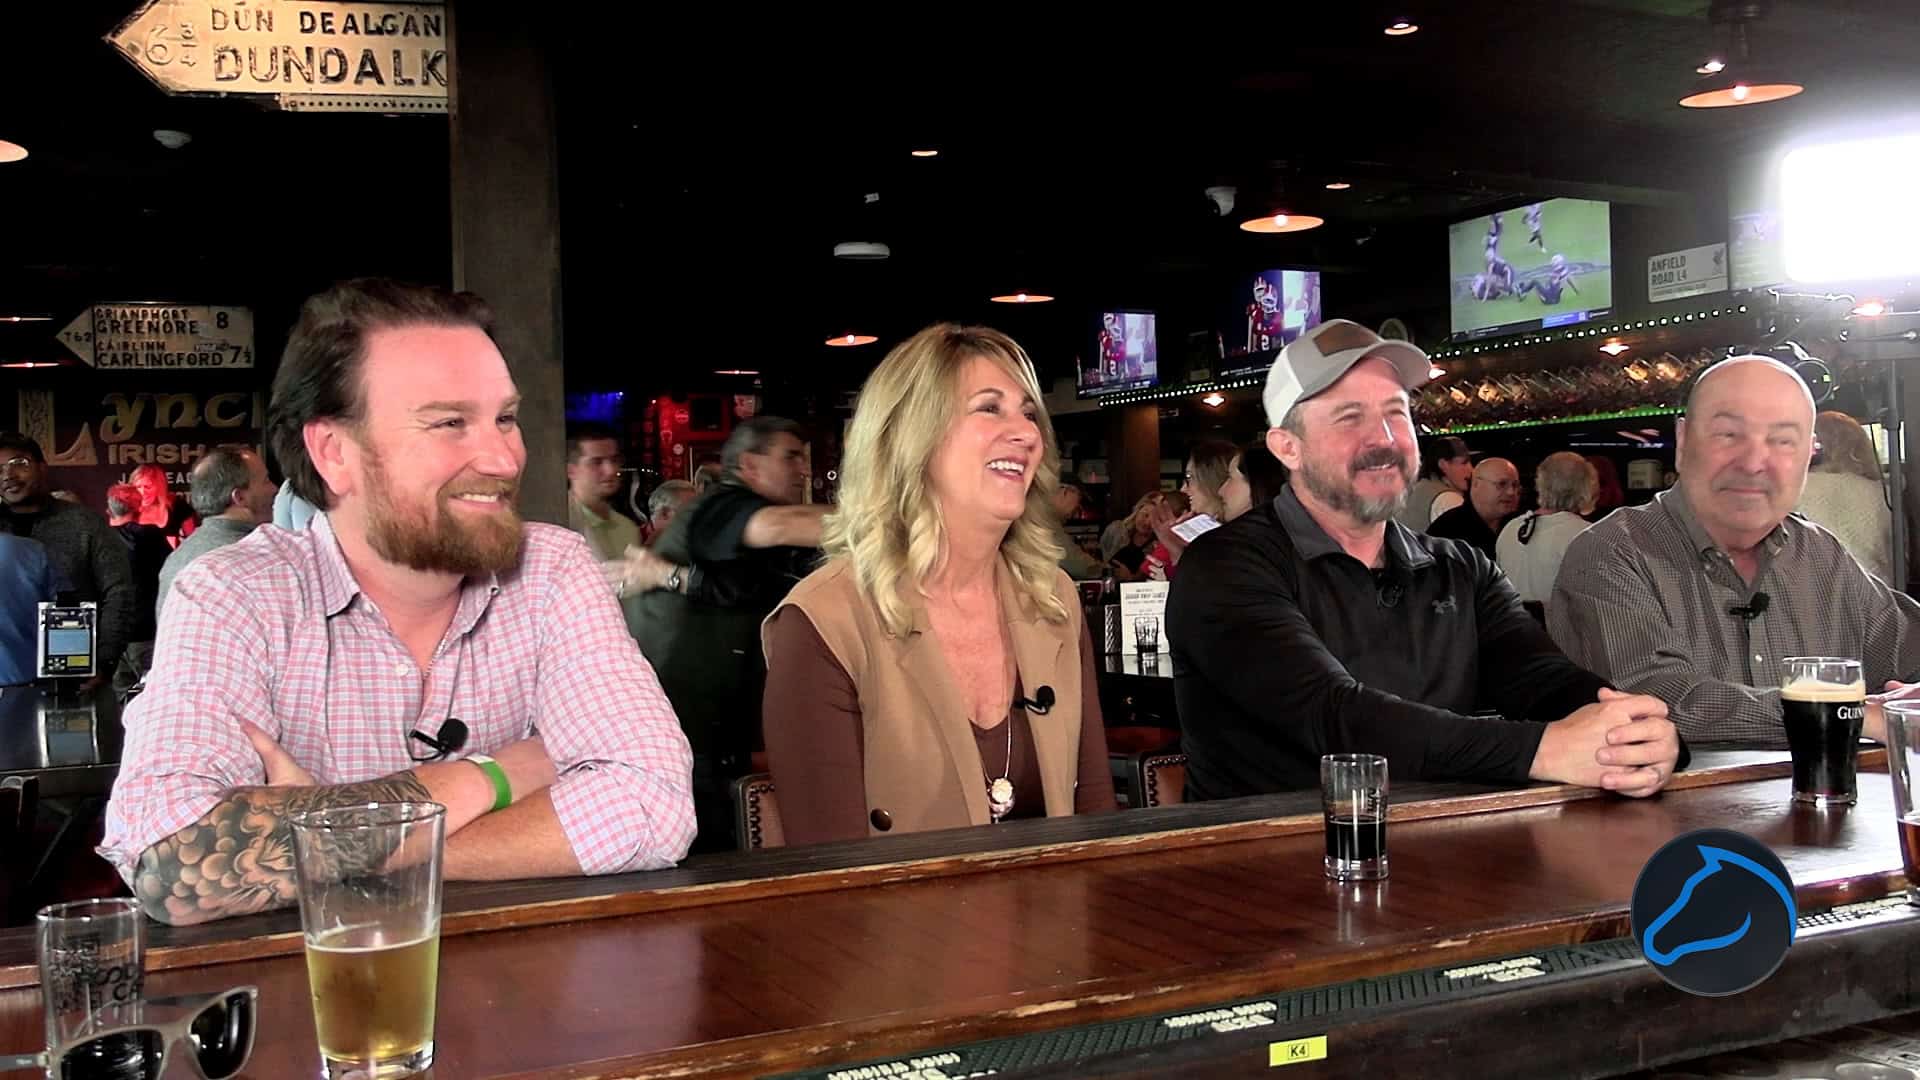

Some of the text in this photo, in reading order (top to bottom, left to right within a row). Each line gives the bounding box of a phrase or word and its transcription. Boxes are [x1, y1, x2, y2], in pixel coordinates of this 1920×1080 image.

[213, 45, 448, 87] DUNDALK
[1651, 256, 1686, 273] ANFIELD
[97, 312, 229, 335] GREENORE 8
[98, 352, 223, 367] CARLINGFORD
[107, 443, 203, 466] IRISH
[1290, 1045, 1305, 1057] K4
